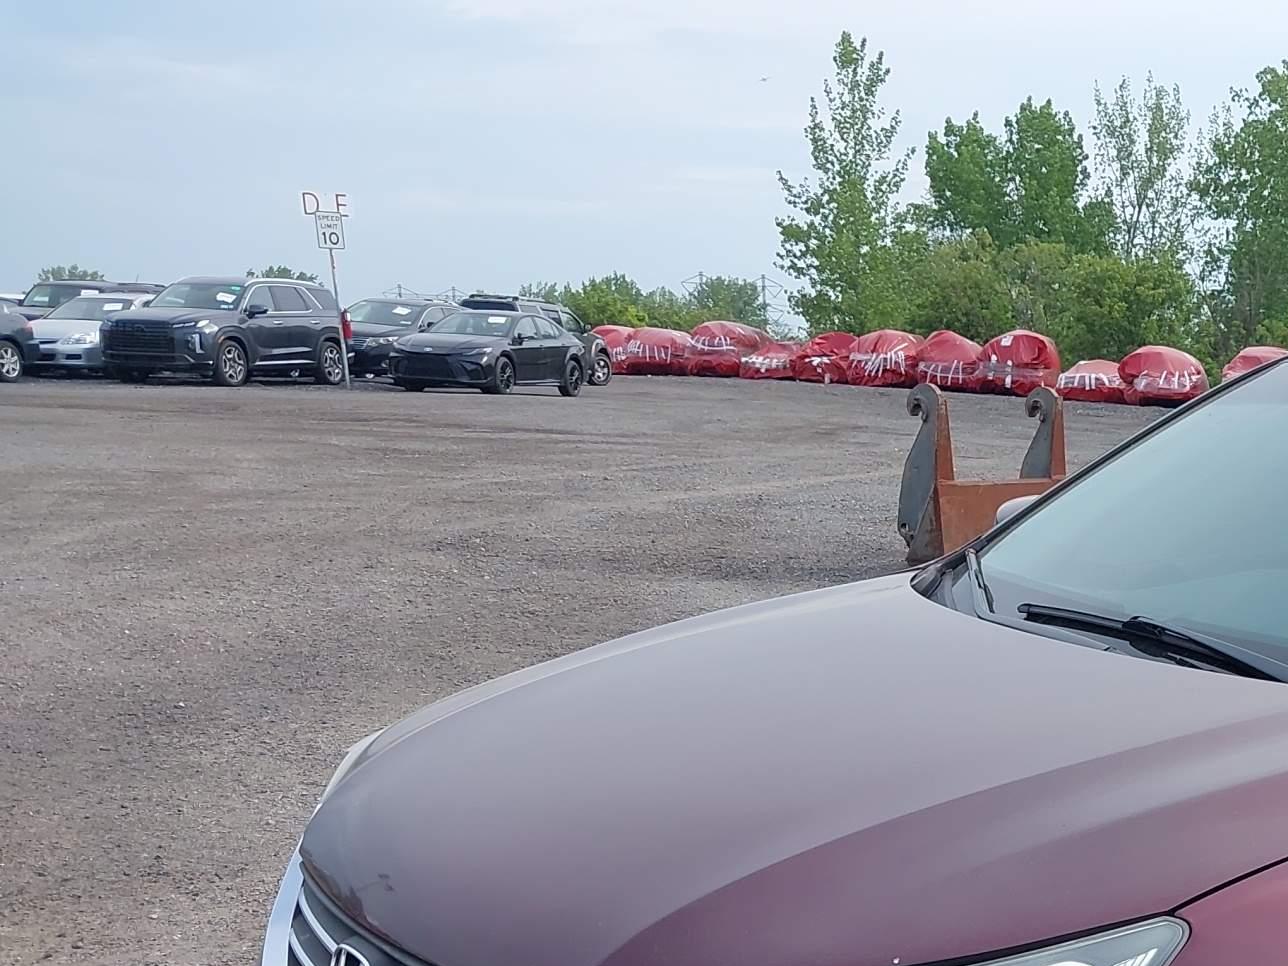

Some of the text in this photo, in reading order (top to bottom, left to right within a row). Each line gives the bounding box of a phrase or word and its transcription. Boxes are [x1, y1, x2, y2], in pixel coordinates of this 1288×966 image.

[302, 192, 320, 215] D
[317, 214, 341, 222] SPEED
[322, 231, 340, 246] 10
